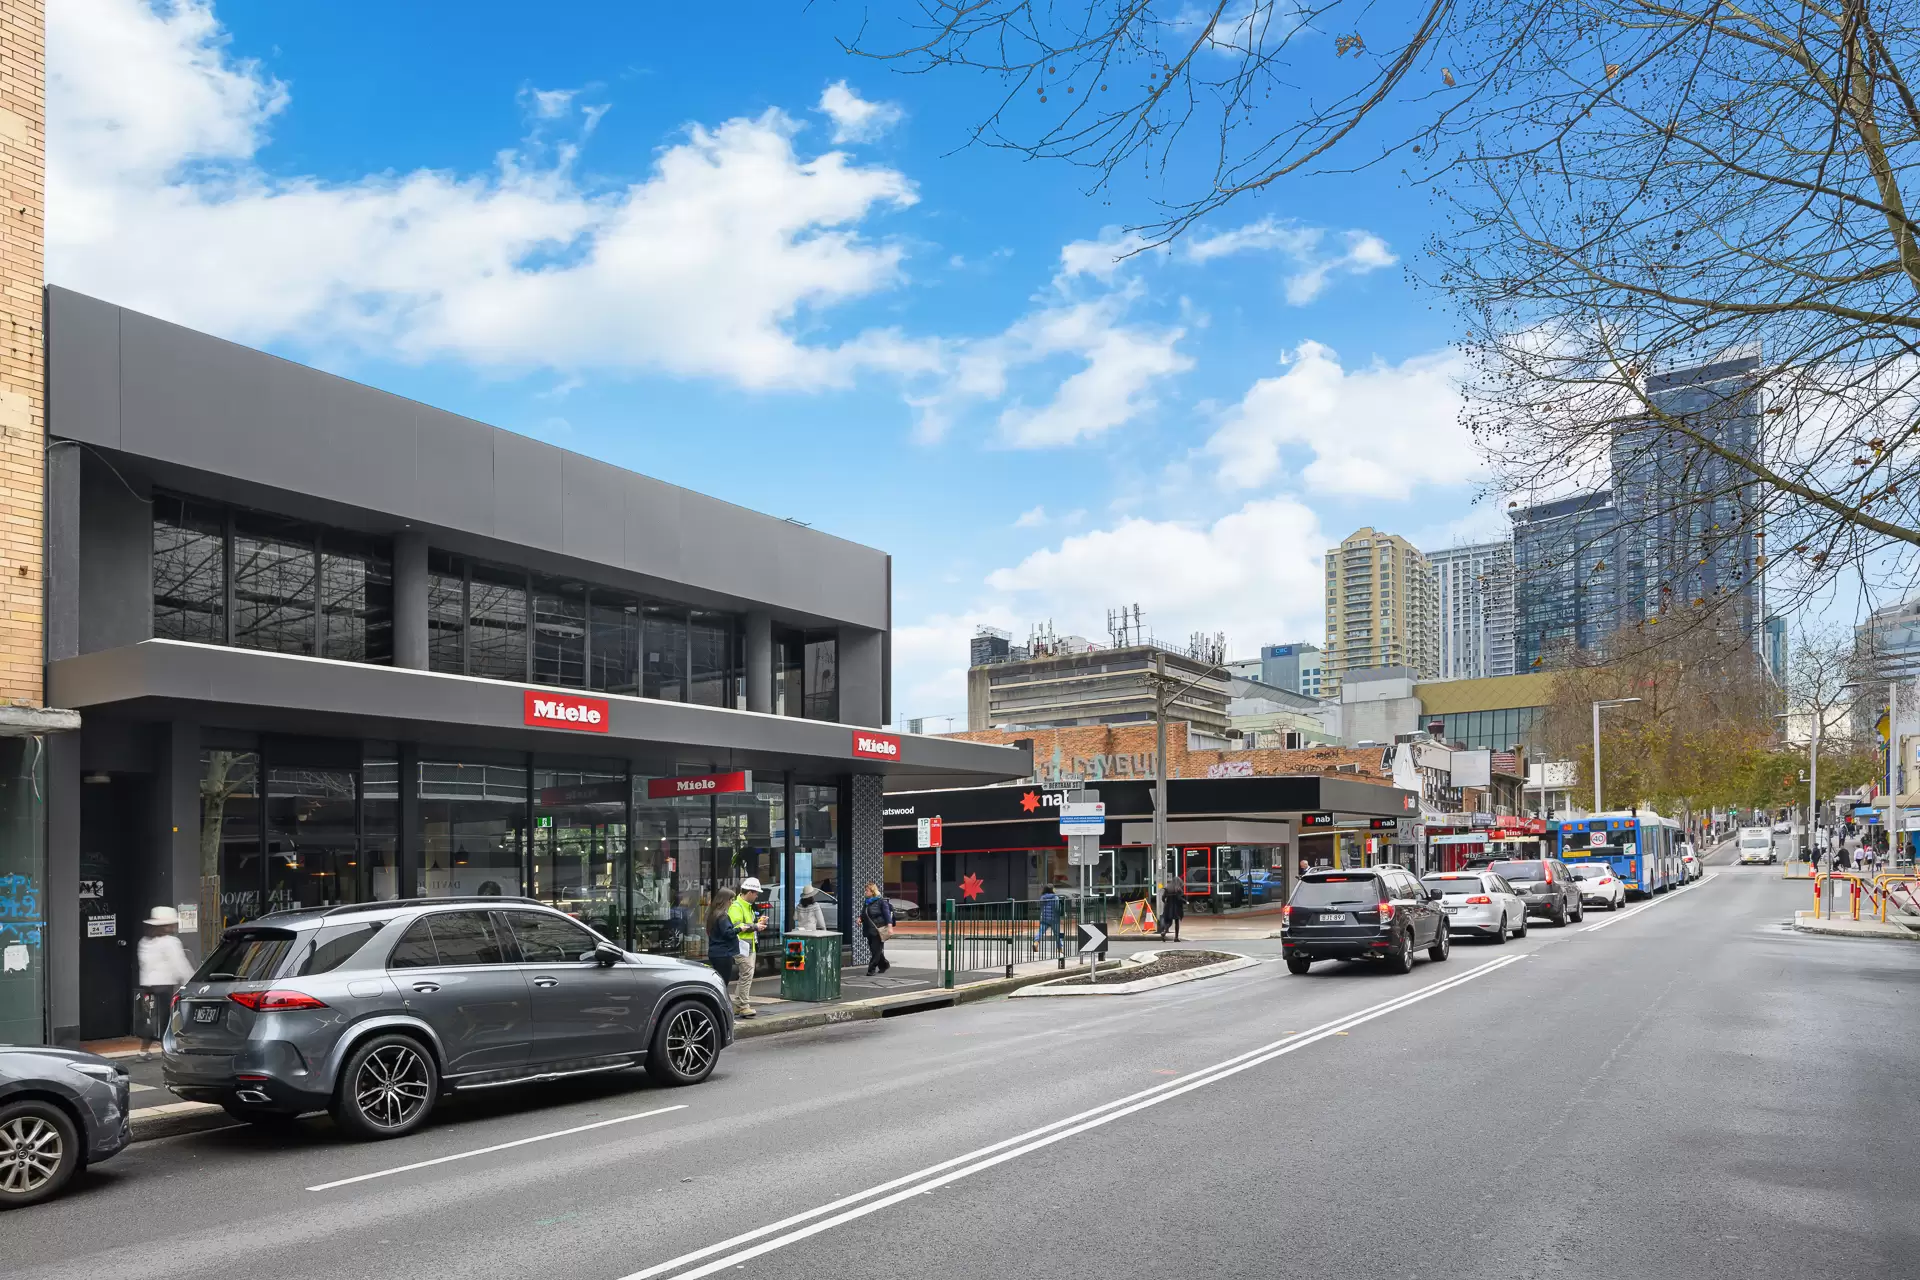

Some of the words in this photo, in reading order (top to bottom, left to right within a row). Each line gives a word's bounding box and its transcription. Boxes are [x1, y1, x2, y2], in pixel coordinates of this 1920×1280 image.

[533, 699, 601, 724] Miele
[857, 738, 897, 755] Miele
[676, 779, 716, 792] Miele
[882, 806, 915, 816] atswood
[1315, 815, 1331, 823] nab
[1381, 819, 1395, 827] nab
[1593, 834, 1604, 843] 40
